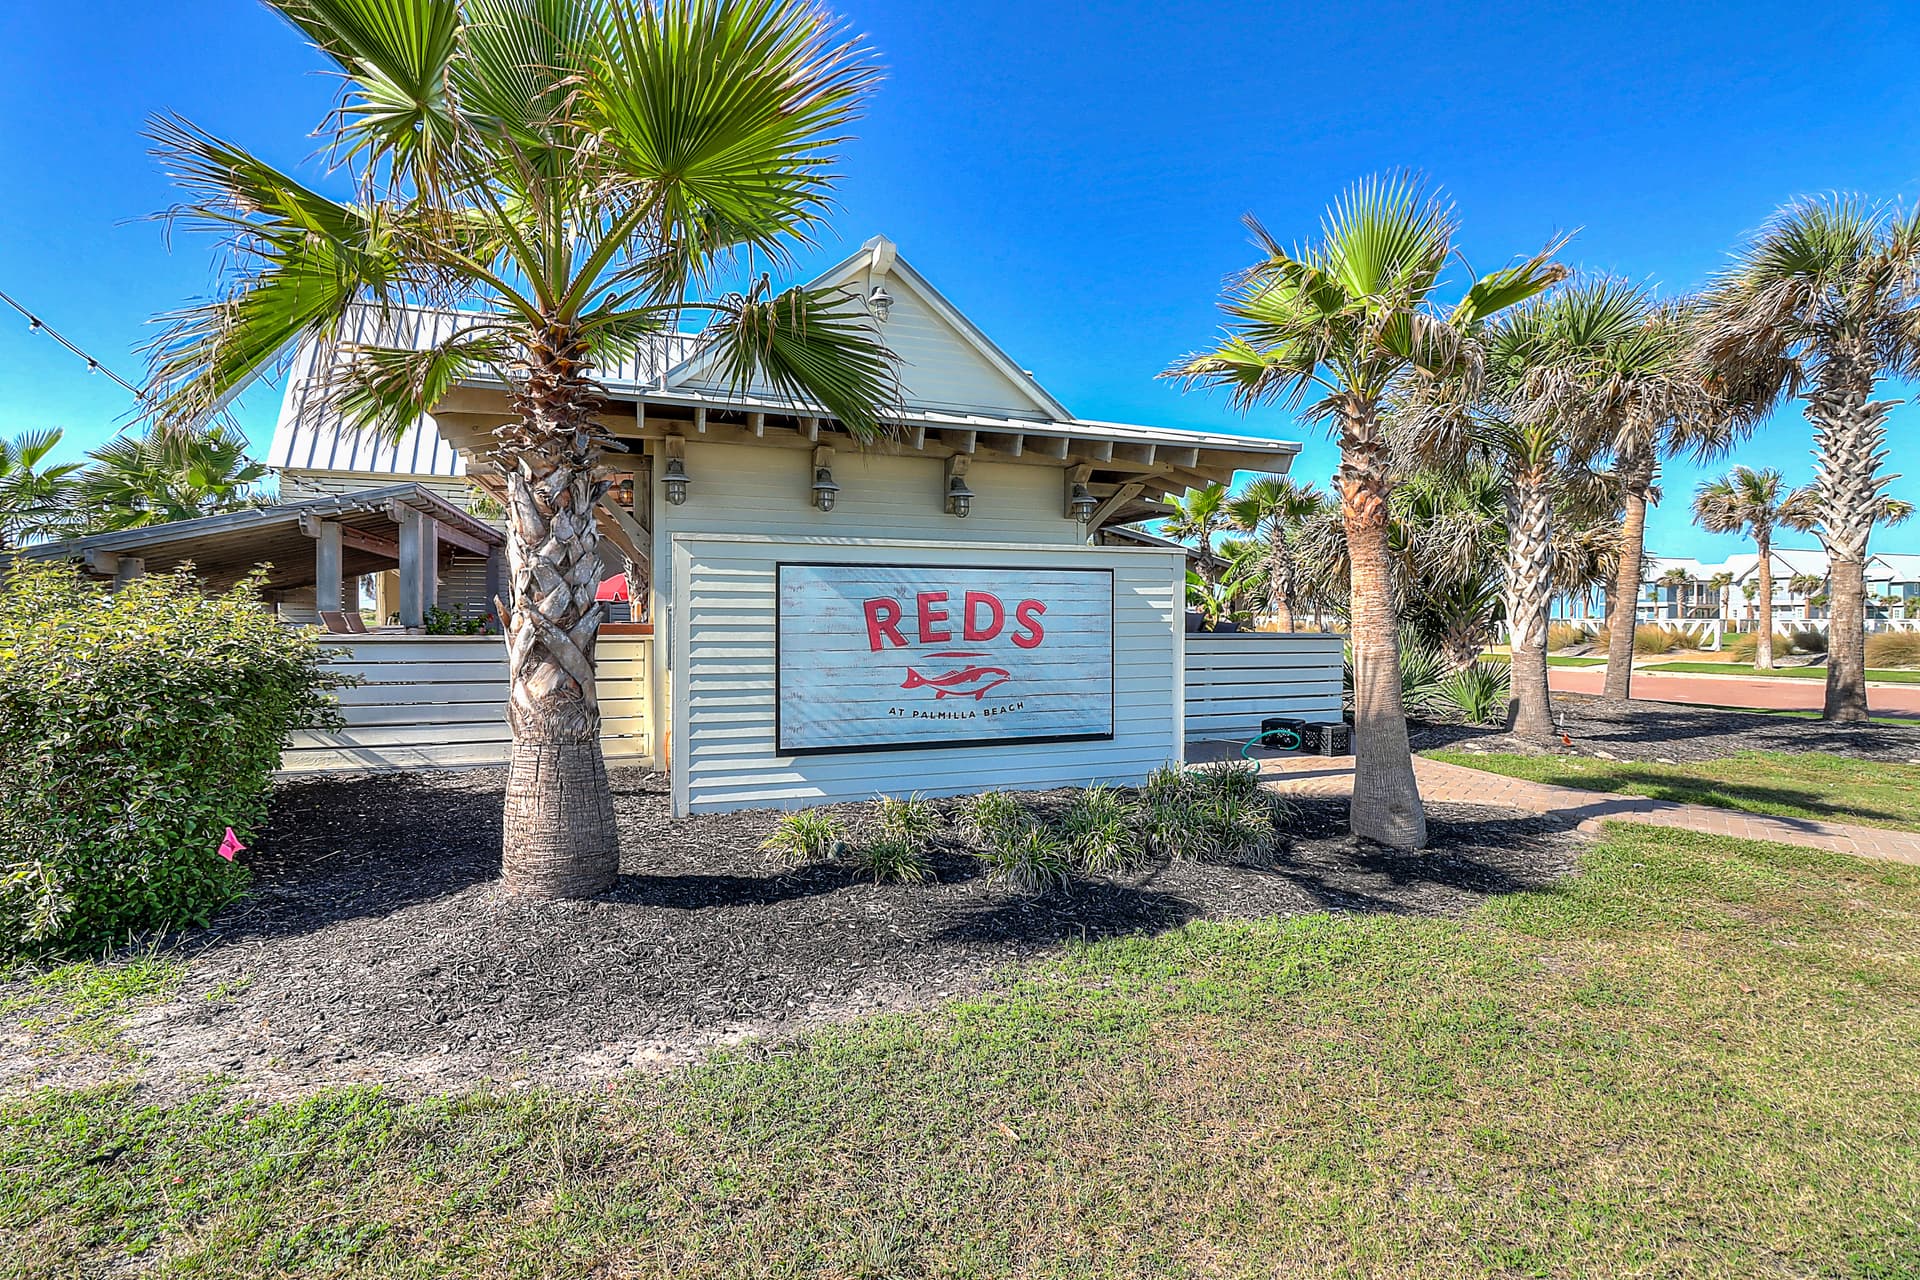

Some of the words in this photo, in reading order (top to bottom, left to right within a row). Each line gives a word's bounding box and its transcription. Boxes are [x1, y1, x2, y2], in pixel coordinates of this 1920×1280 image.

[863, 590, 1047, 652] REDS
[888, 707, 905, 717] AT
[912, 710, 976, 719] PALMILLA
[983, 702, 1024, 717] BEACH
